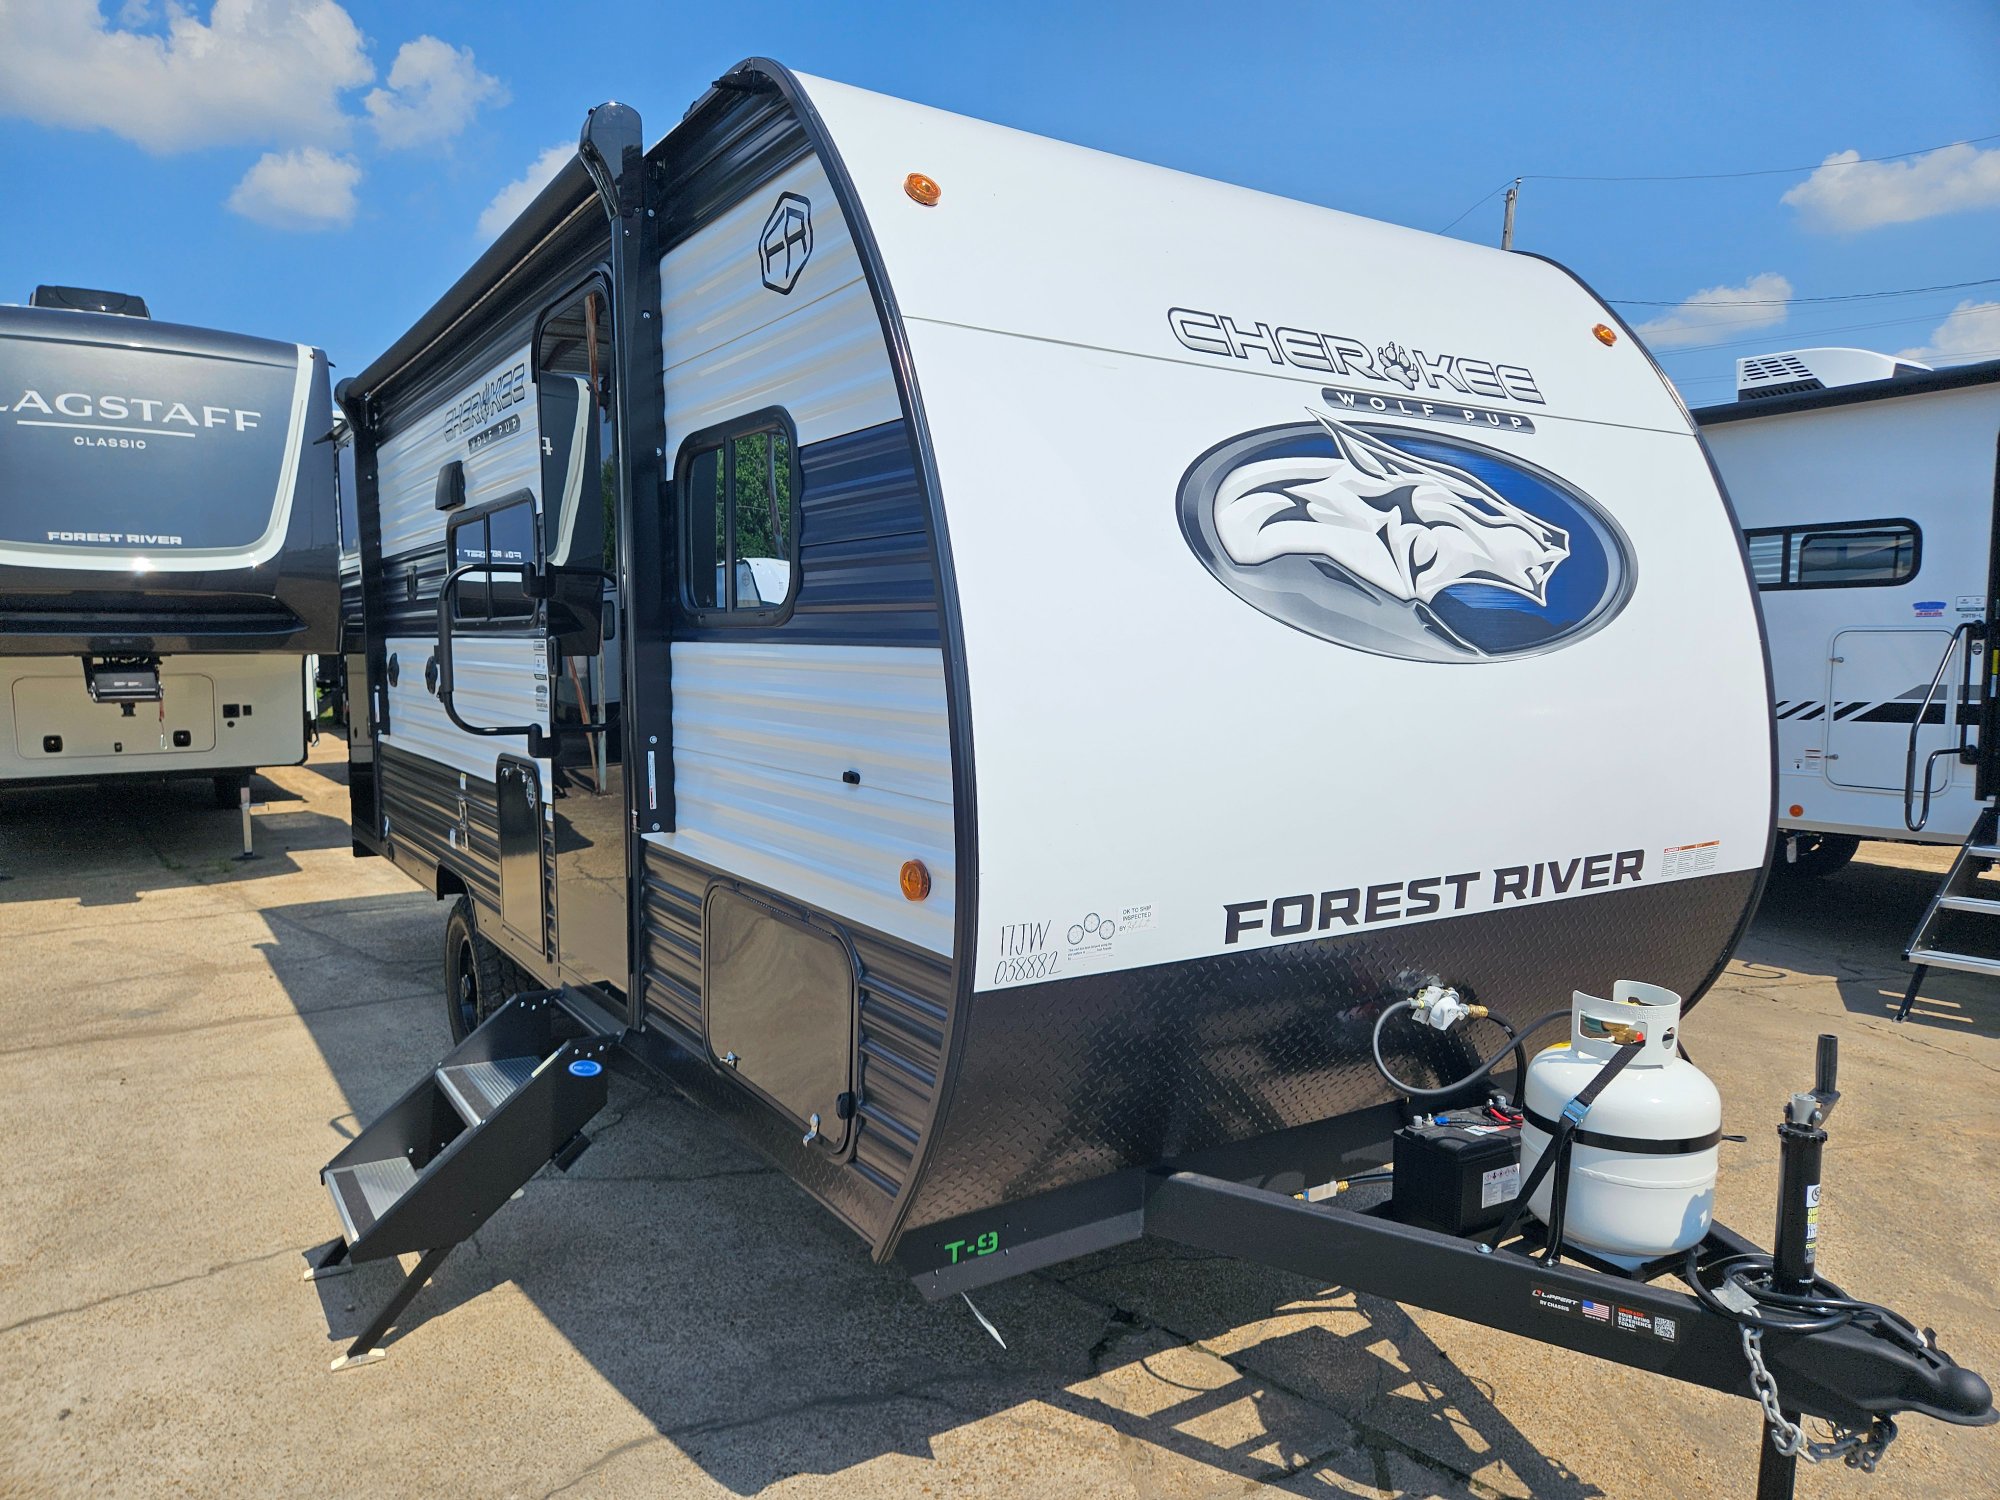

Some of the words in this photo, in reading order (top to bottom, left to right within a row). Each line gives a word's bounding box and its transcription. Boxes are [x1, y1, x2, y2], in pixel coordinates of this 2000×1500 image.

[0, 389, 262, 432] AGSTAFF
[1336, 391, 1435, 418] WOLF
[1464, 408, 1522, 429] PUP
[498, 418, 517, 434] PUP
[74, 435, 147, 449] CLASSIC
[47, 531, 123, 543] FOREST
[127, 533, 183, 545] RIVER
[1223, 871, 1481, 945] FOREST
[1493, 848, 1645, 904] RIVER
[1122, 911, 1152, 921] INSPECTED
[994, 950, 1063, 984] 038882
[944, 1231, 999, 1265] T-9
[1541, 1292, 1580, 1306] LIPPERT
[1547, 1302, 1570, 1312] CHASSIS
